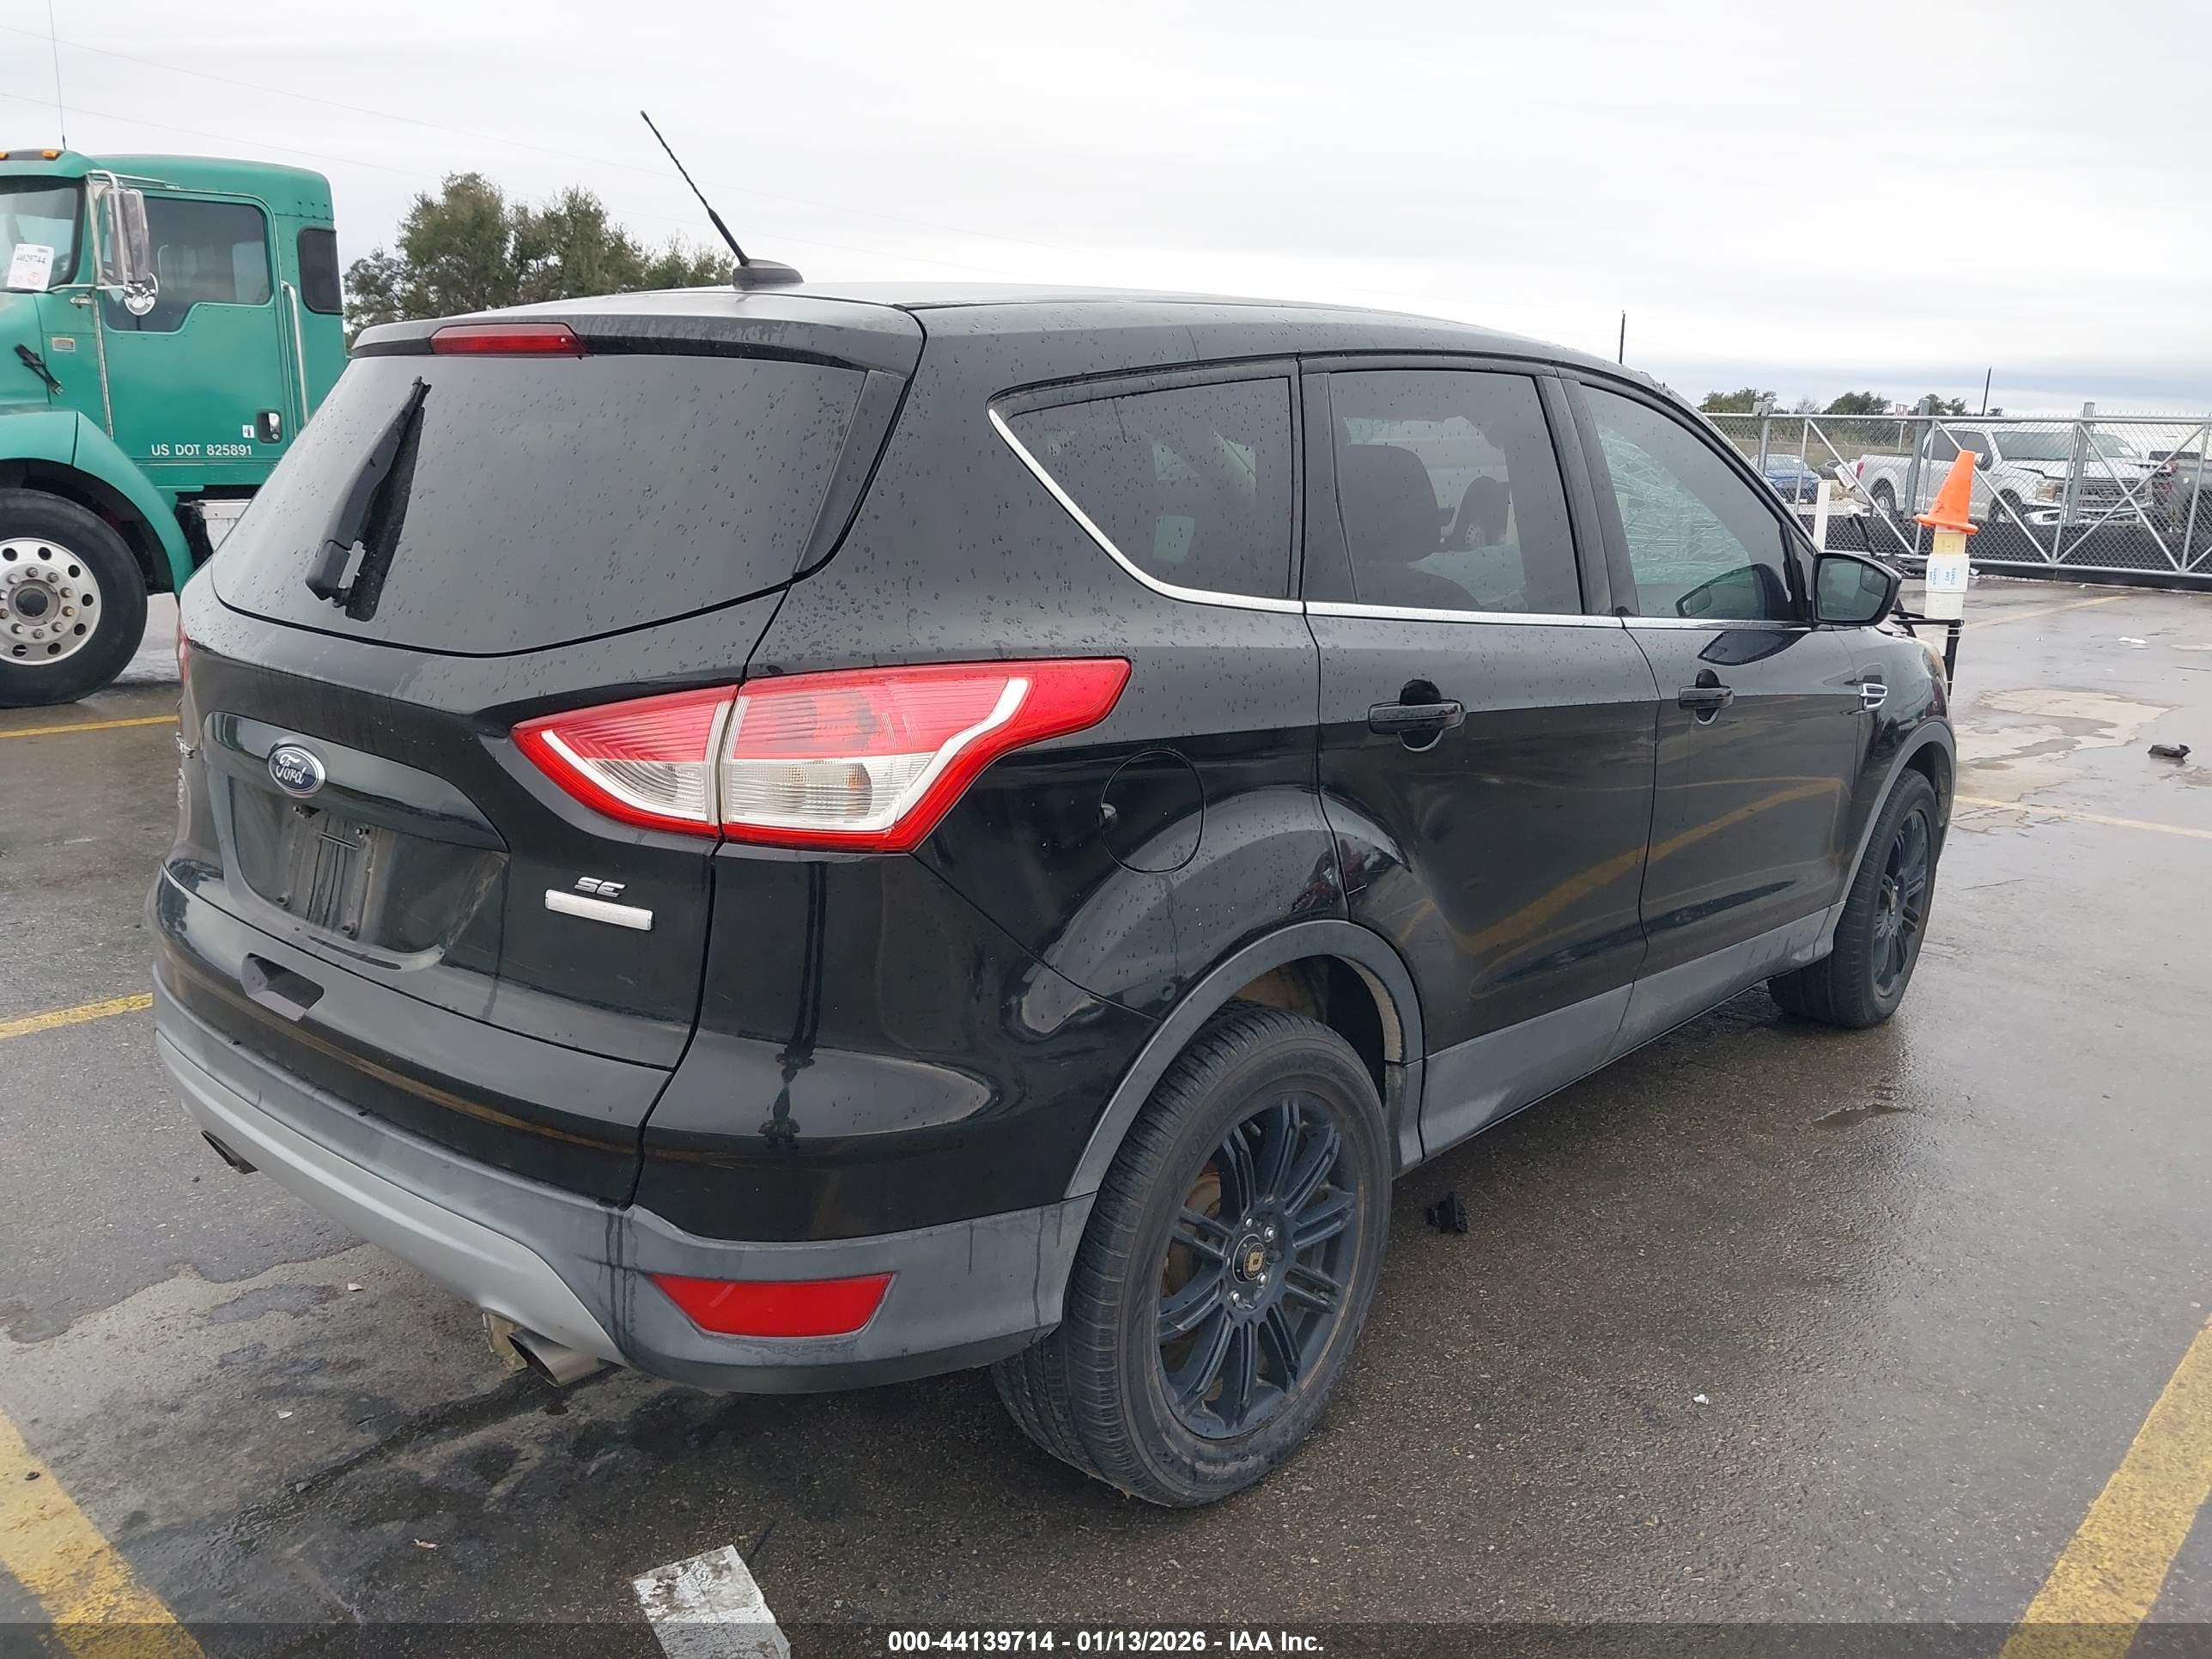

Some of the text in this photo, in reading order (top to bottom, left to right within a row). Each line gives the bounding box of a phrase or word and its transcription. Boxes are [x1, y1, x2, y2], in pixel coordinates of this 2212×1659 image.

[151, 444, 252, 456] US DOT 825891
[276, 754, 307, 785] Ford
[574, 876, 626, 898] SE
